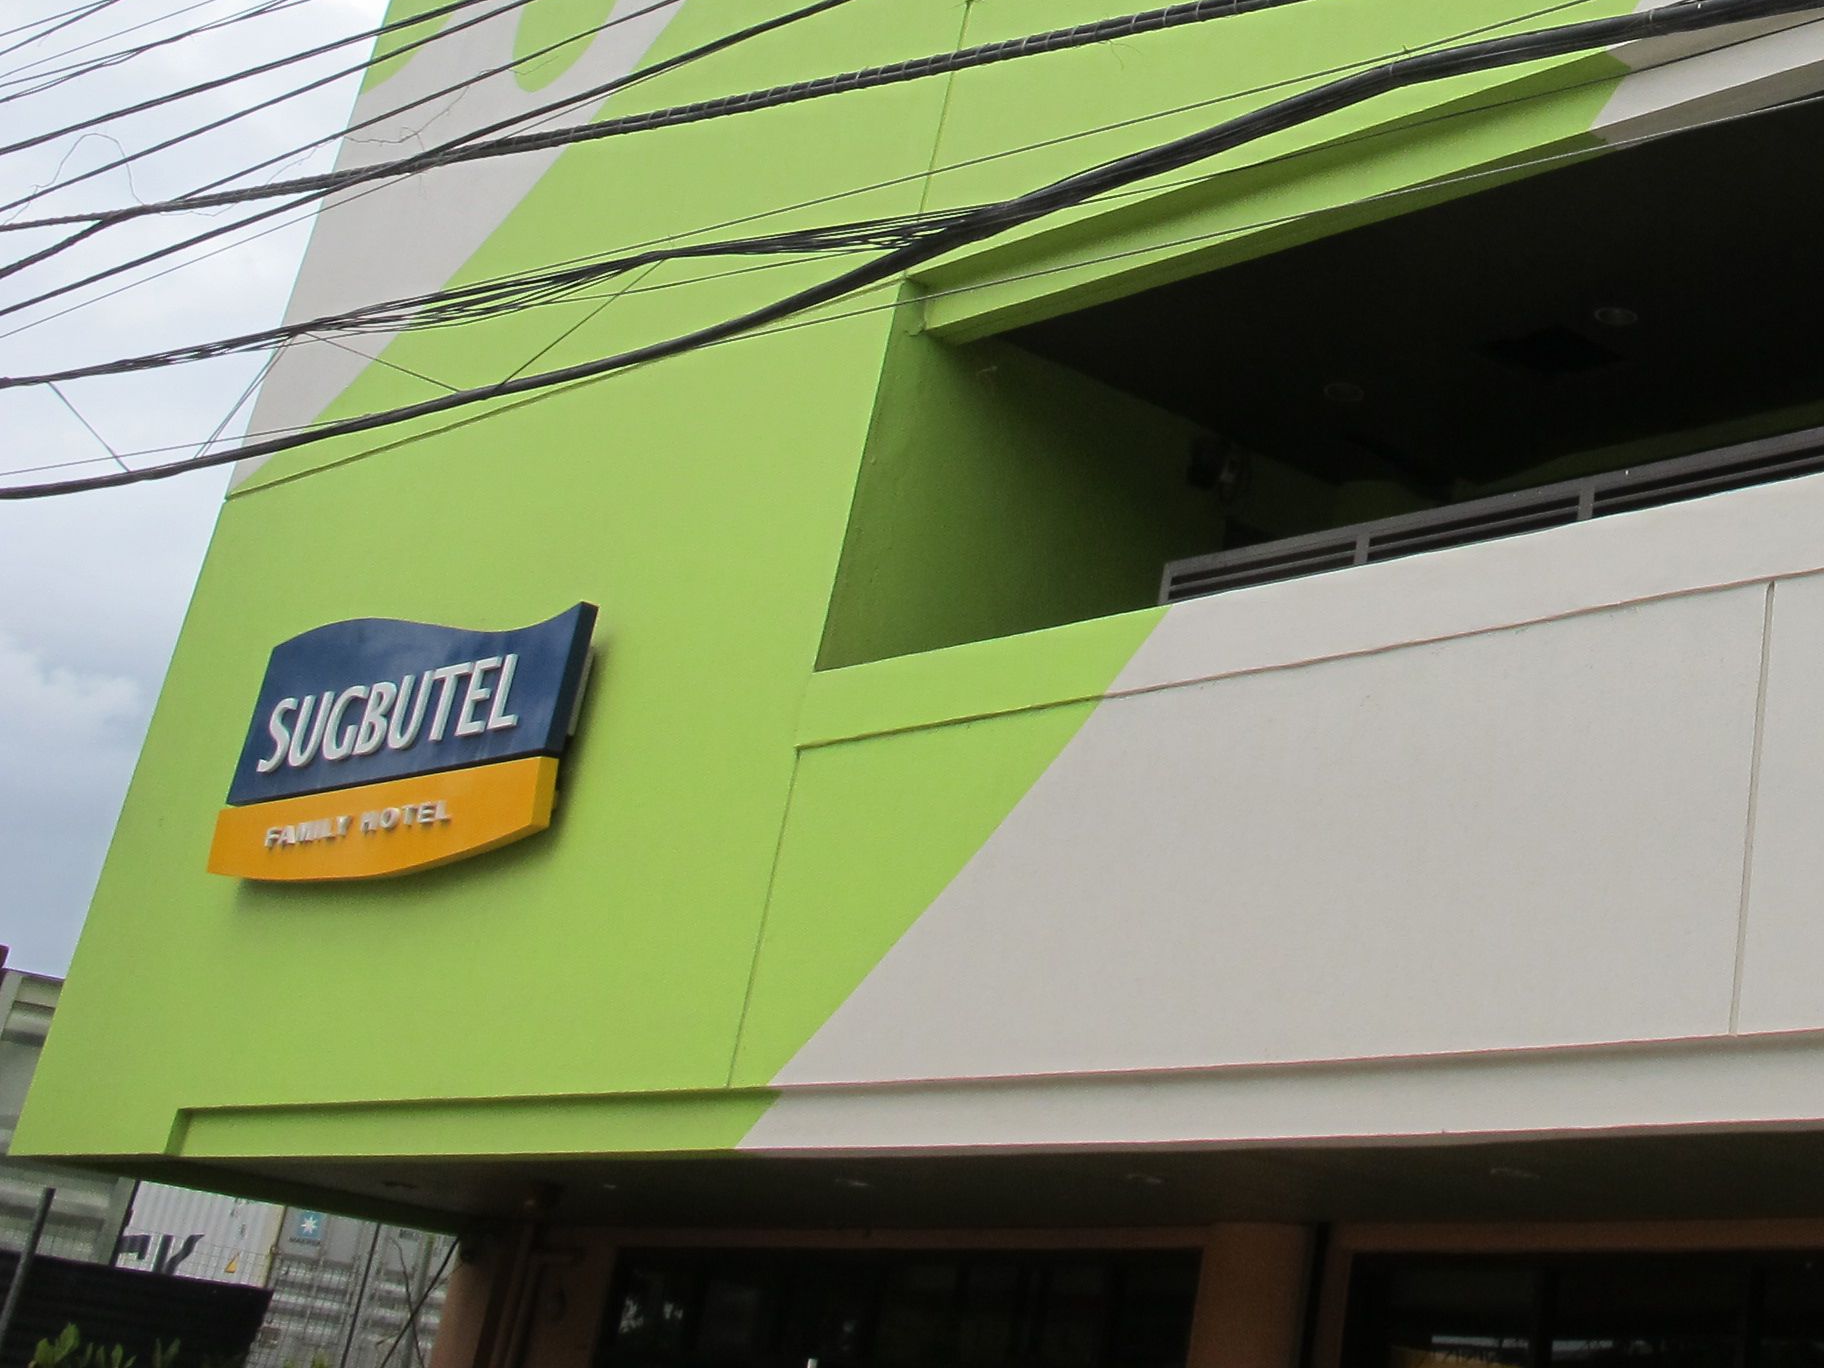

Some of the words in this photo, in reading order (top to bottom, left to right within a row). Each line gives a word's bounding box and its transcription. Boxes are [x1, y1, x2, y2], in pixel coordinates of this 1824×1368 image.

[256, 653, 520, 774] SUGBUTEL
[264, 815, 351, 849] FAMILY
[361, 801, 452, 834] HOTEL
